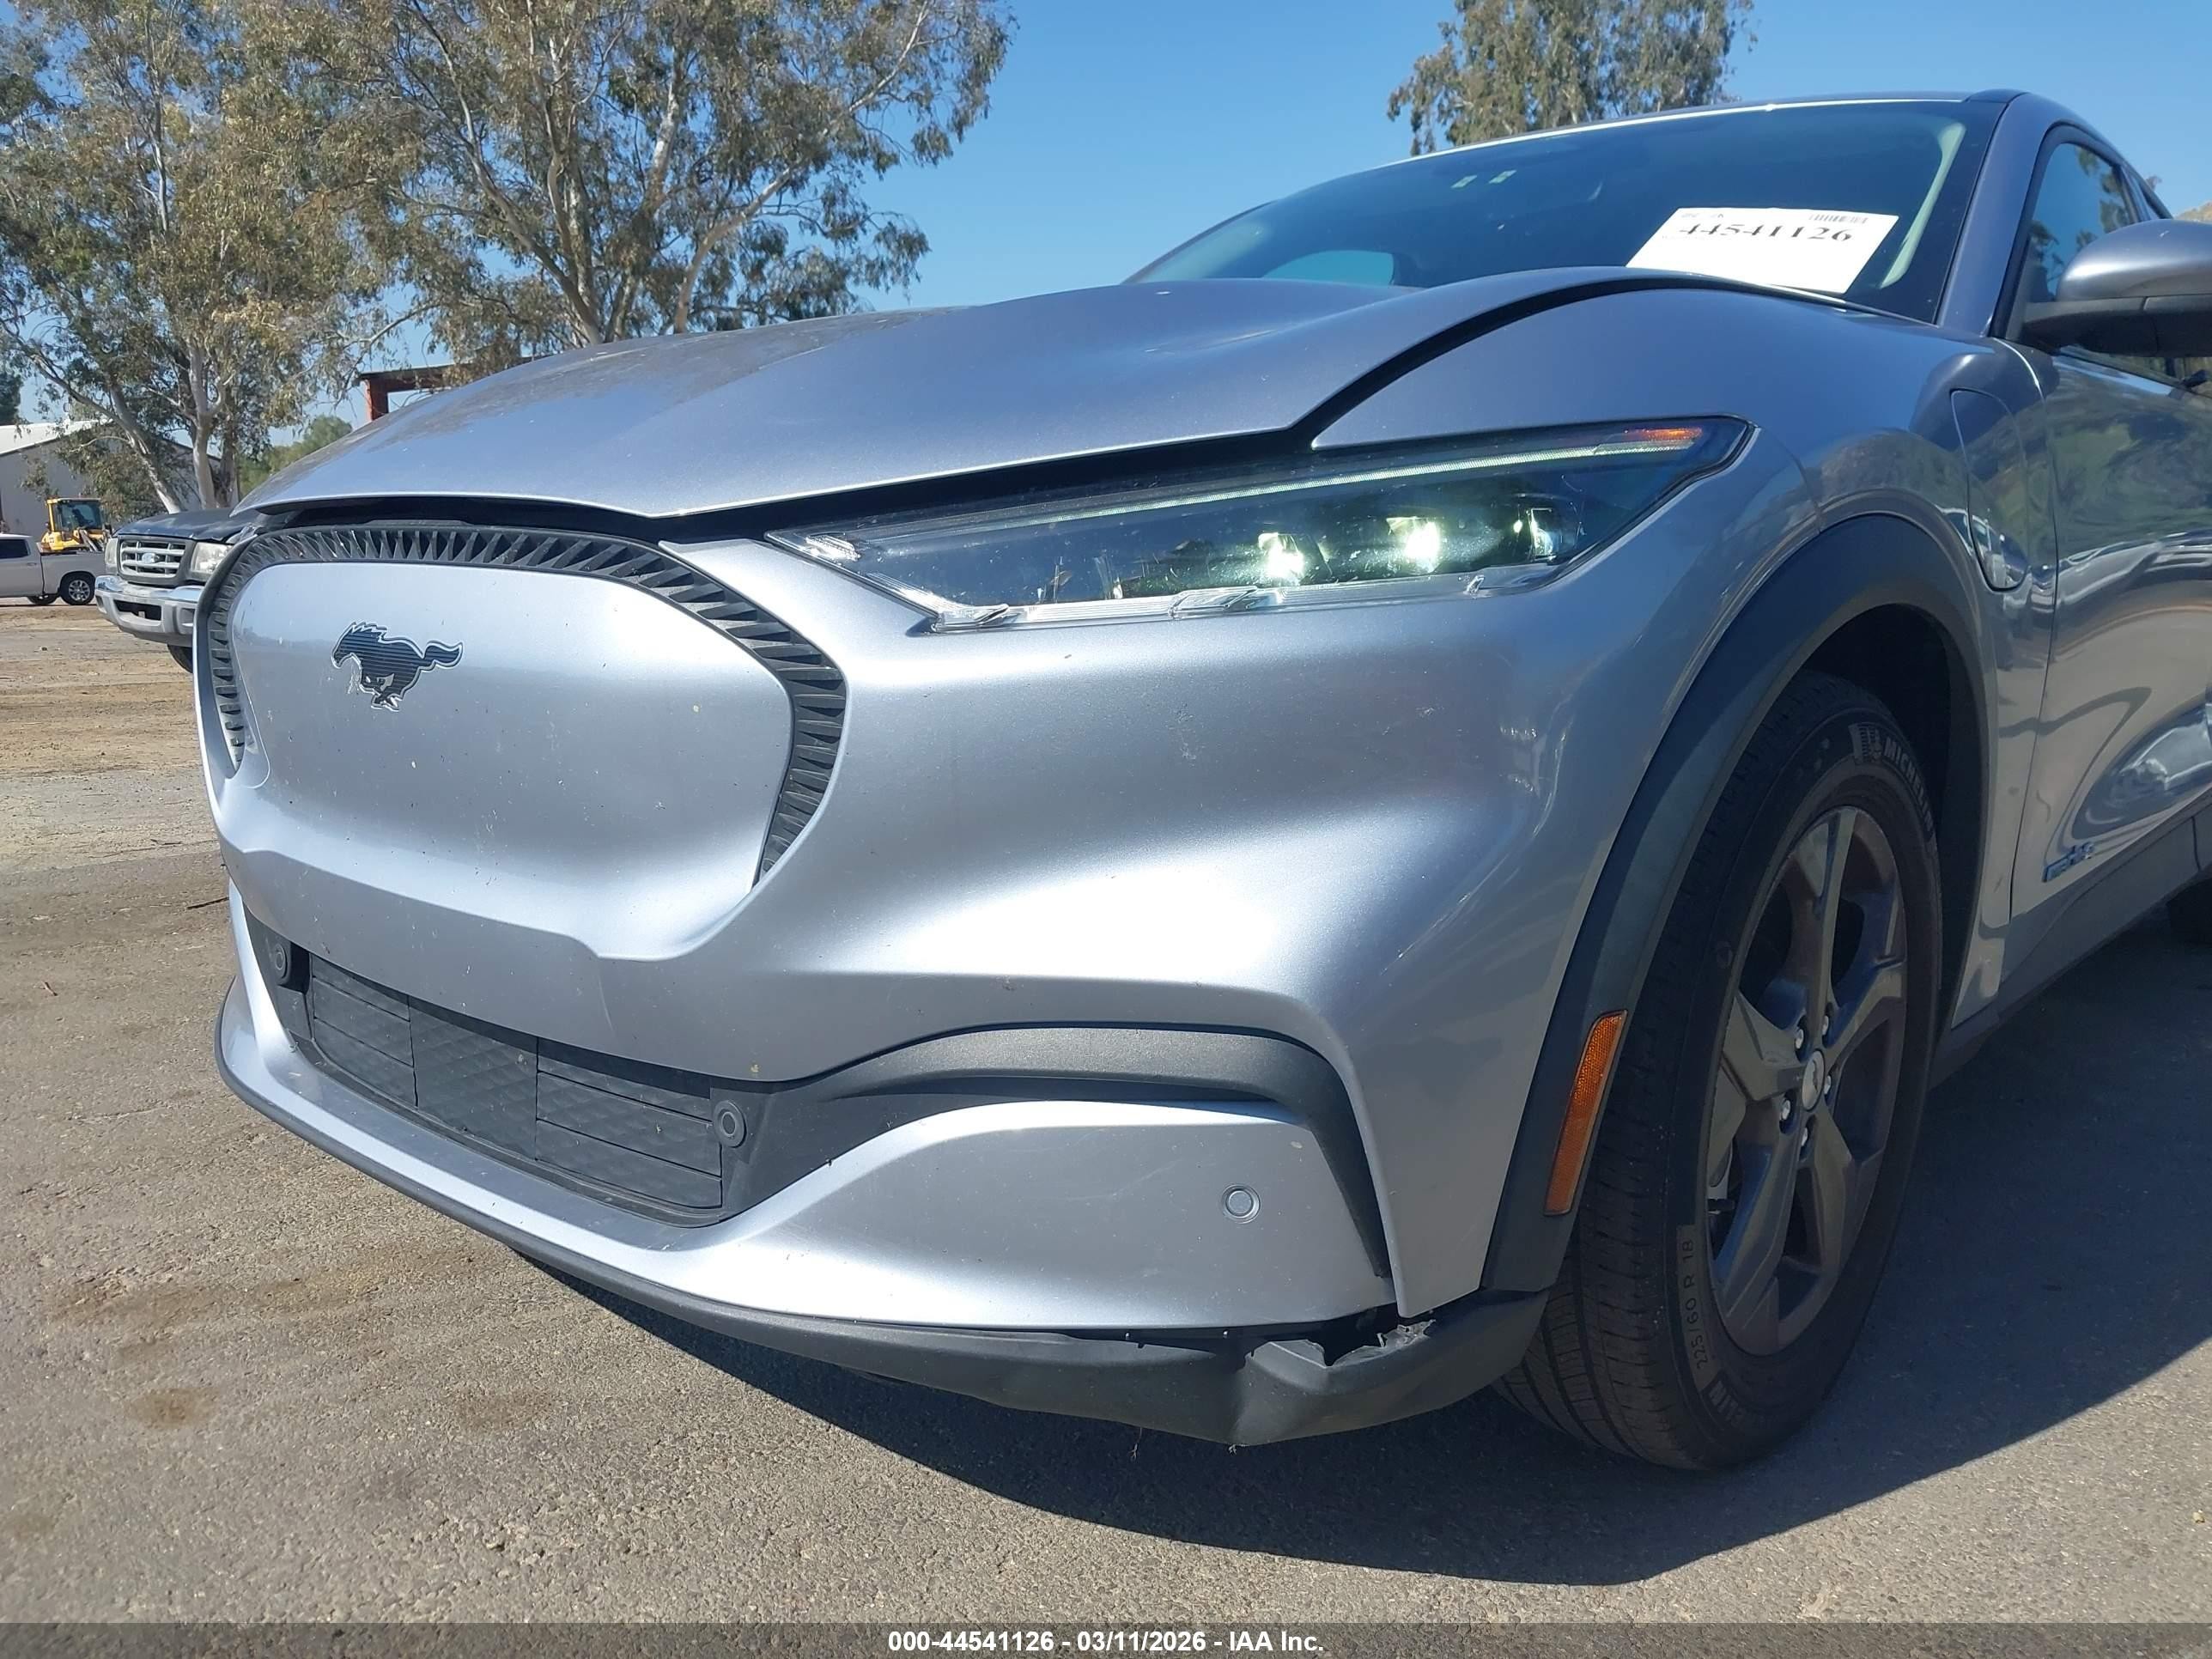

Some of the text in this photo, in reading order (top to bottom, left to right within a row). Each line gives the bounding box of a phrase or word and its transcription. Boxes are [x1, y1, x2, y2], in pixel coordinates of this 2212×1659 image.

[1680, 223, 1851, 240] 44541126
[1883, 736, 1934, 832] MICHELIN
[1682, 1239, 1709, 1370] 225/60 R 18
